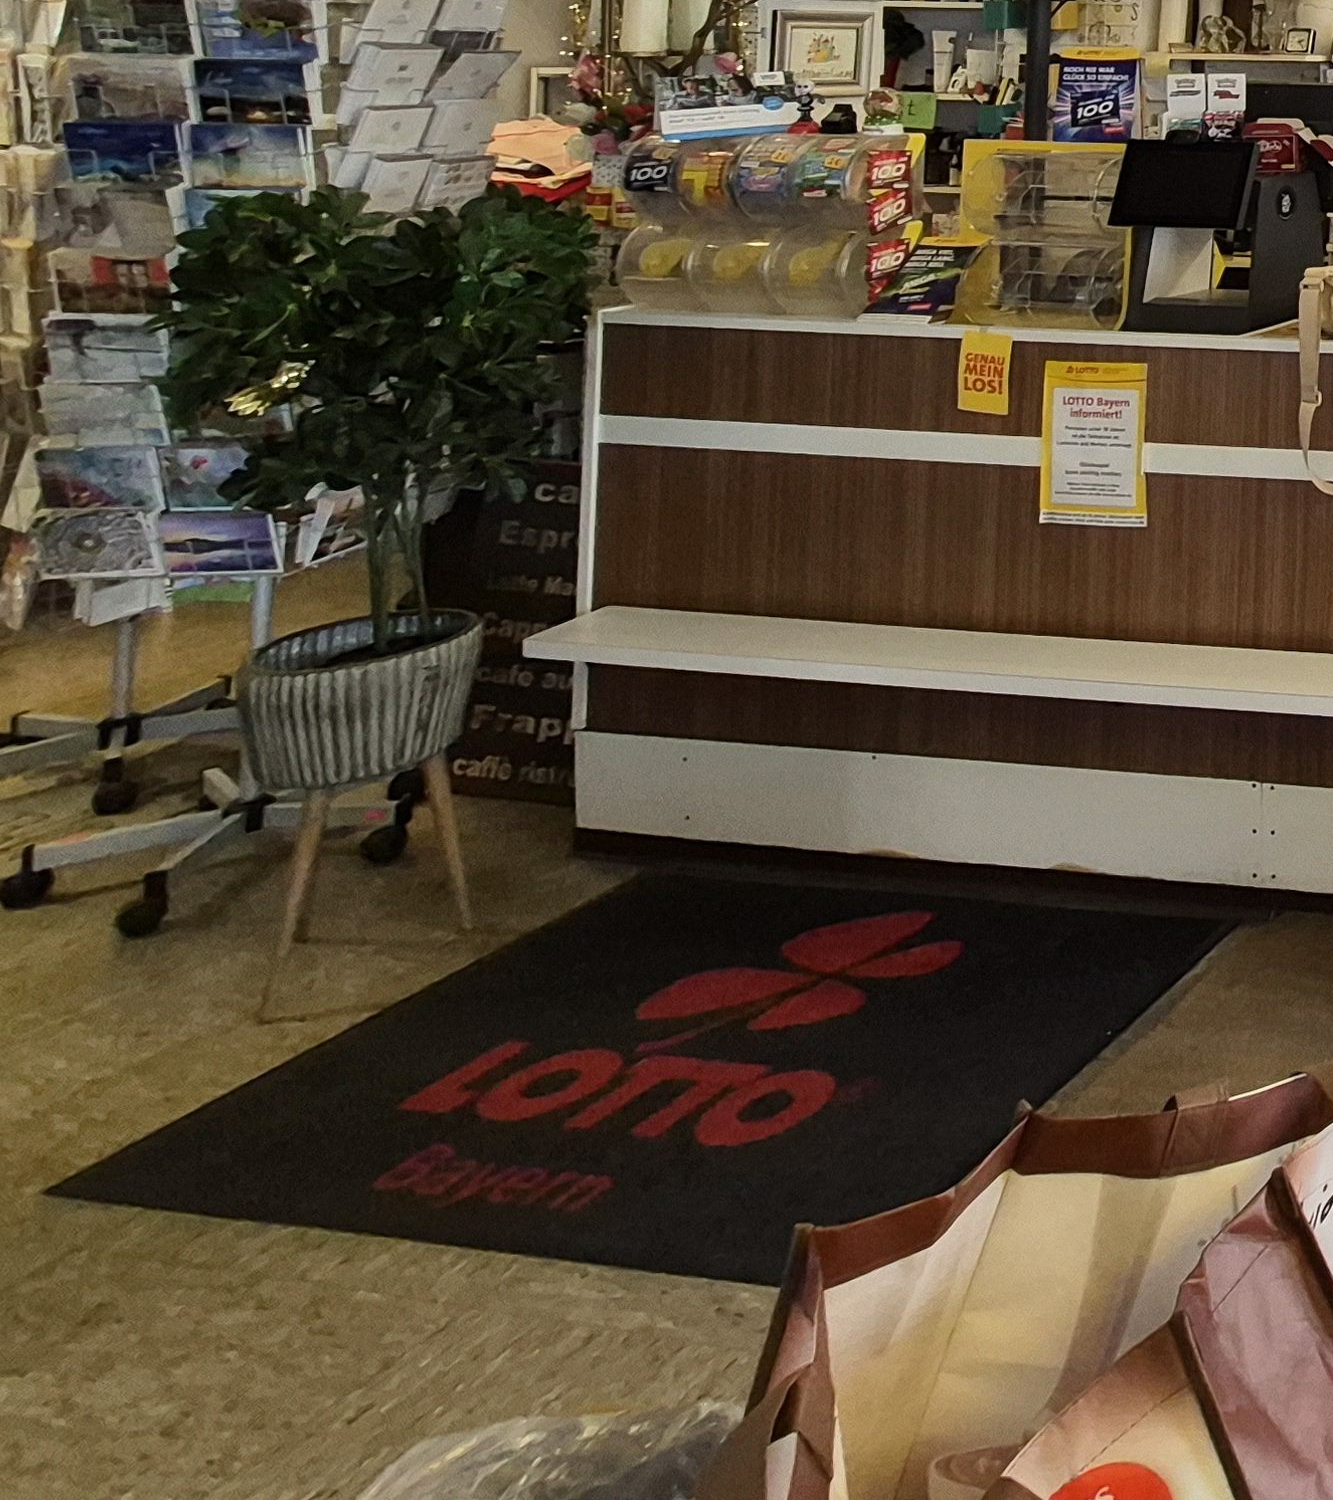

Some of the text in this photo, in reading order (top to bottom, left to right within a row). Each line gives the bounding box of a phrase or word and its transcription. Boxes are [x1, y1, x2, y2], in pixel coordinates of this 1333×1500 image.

[1077, 101, 1113, 119] 100
[630, 166, 667, 180] 100
[872, 164, 906, 176] 100
[873, 200, 906, 225] 100
[871, 253, 905, 271] 100
[965, 353, 1005, 366] GENAU
[964, 364, 1004, 378] MEIN
[964, 377, 1003, 395] LOS!
[1062, 397, 1130, 408] LOTTO Bayern
[1070, 408, 1122, 419] informiert!
[399, 1040, 836, 1147] LOTTO
[372, 1142, 615, 1214] Bayern
